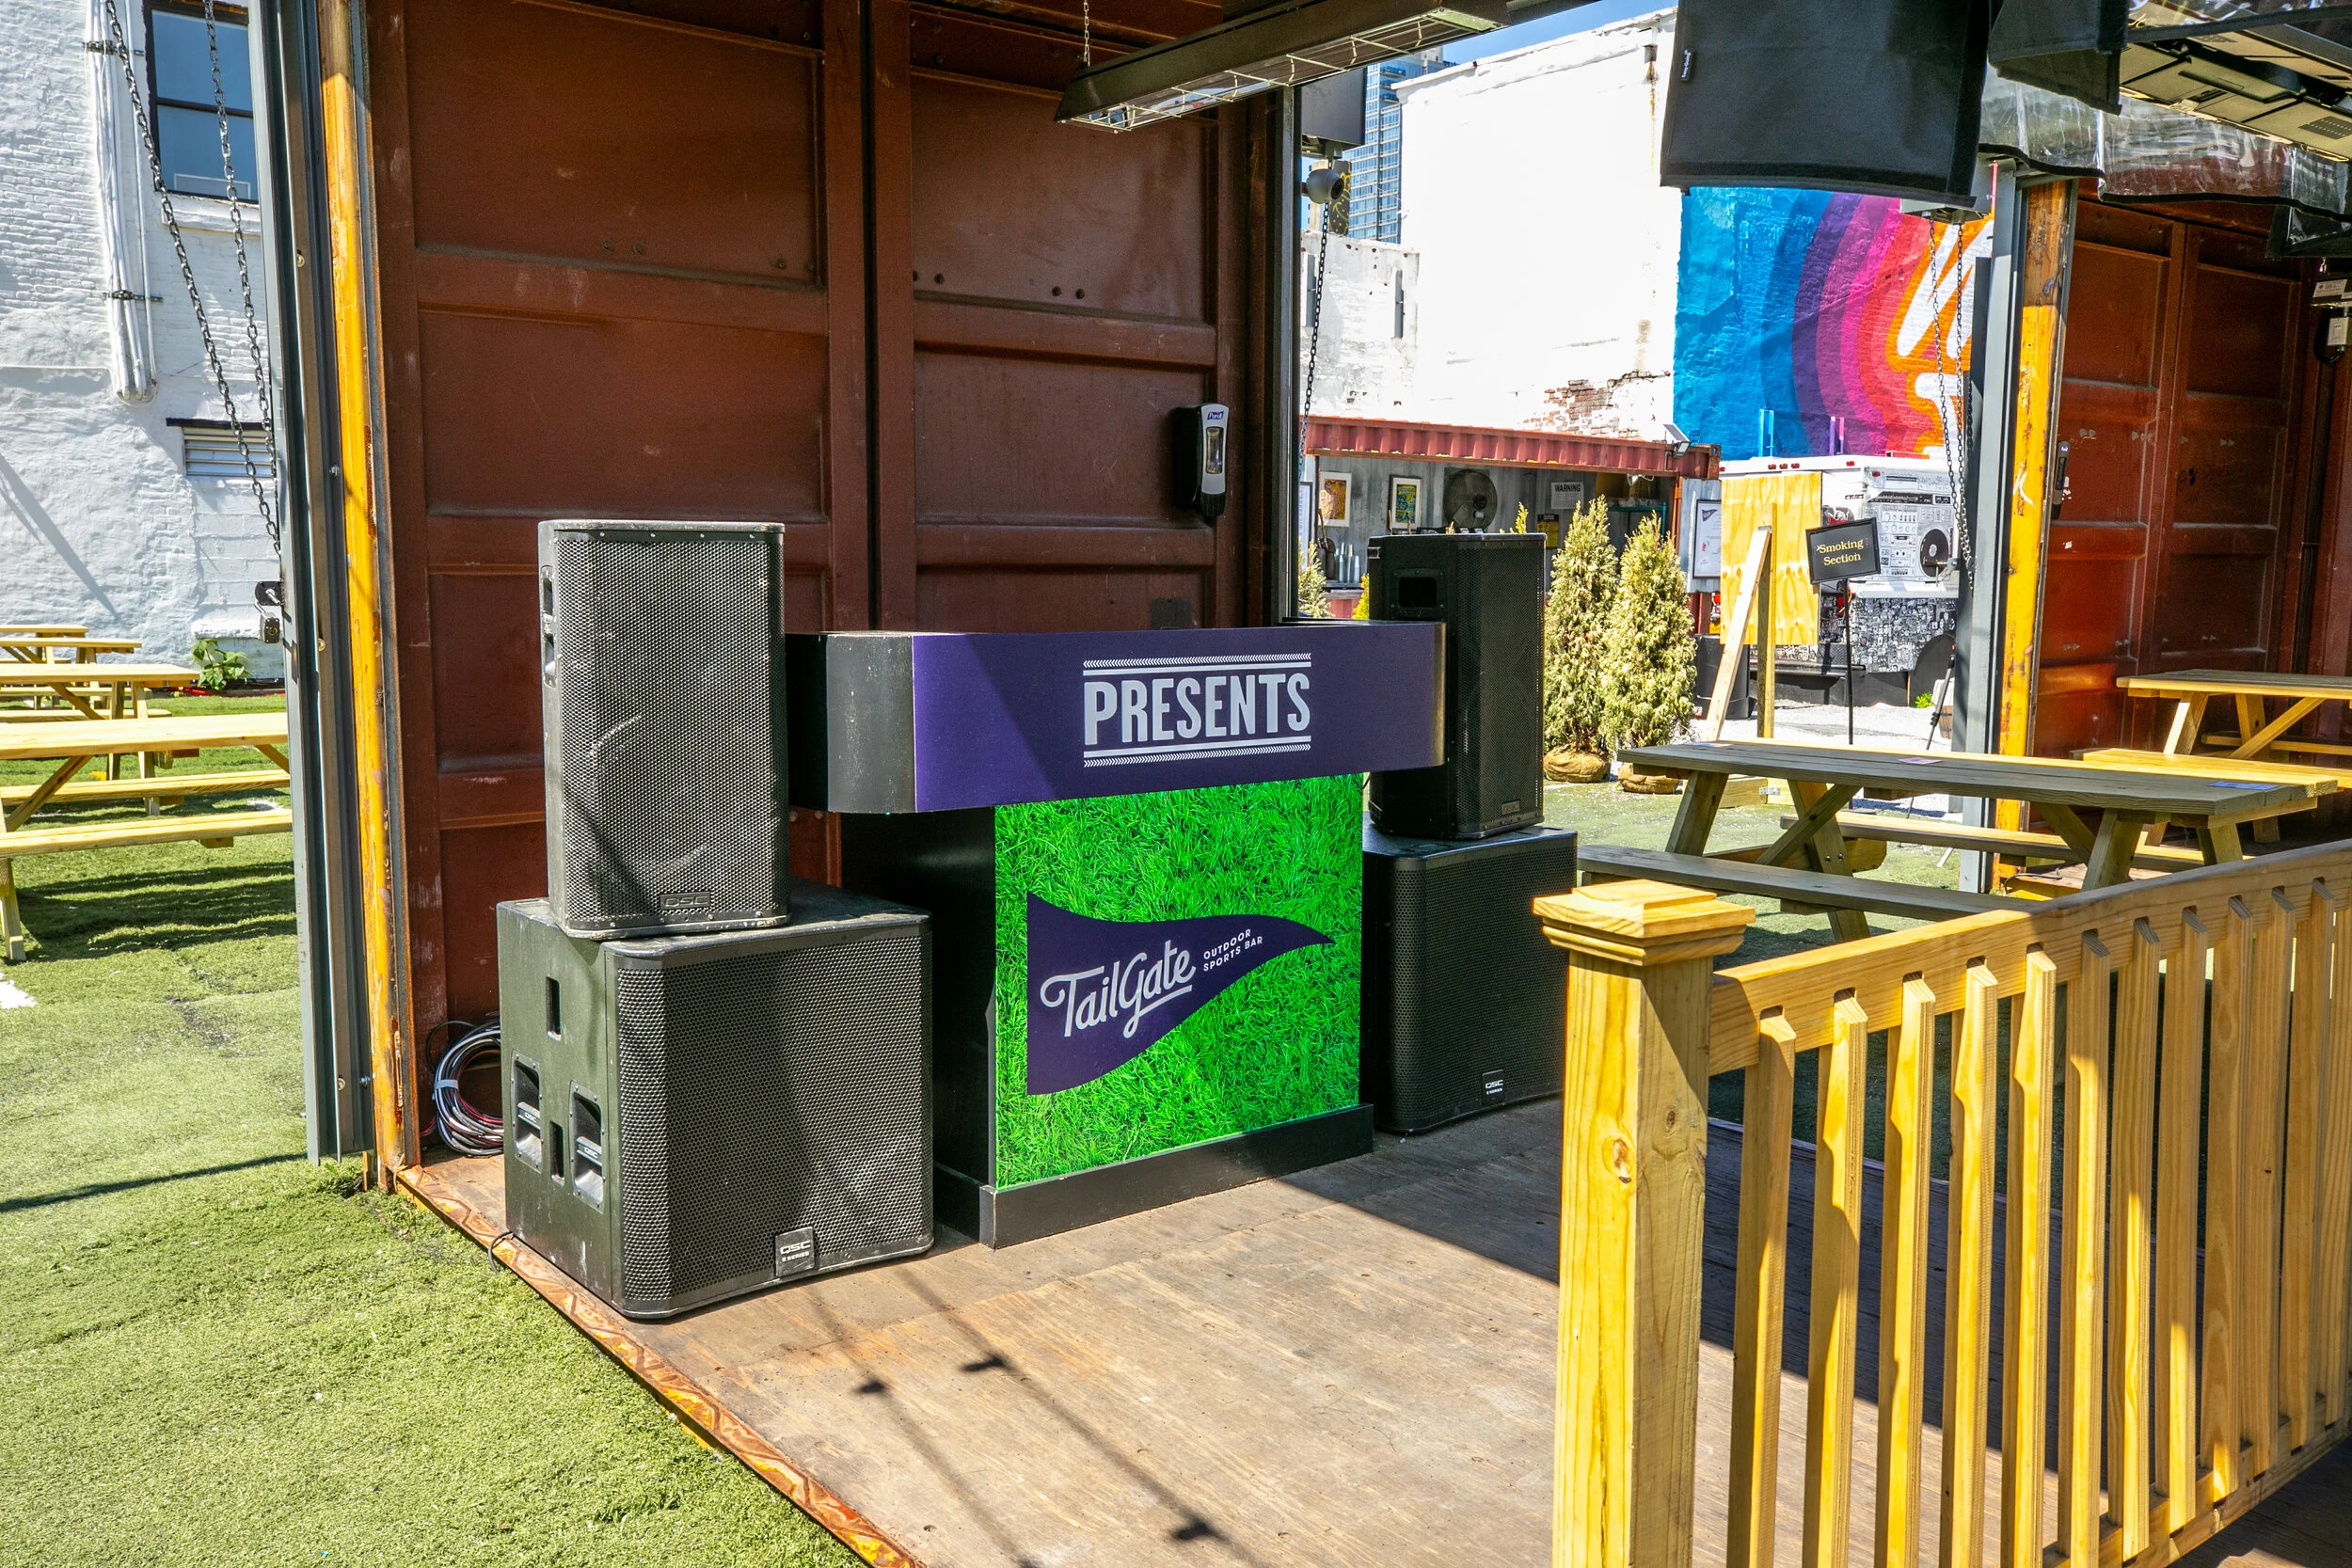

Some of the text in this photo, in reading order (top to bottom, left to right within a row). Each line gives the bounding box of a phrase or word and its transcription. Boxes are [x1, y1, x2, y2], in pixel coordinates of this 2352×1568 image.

[1555, 483, 1581, 492] WARNING
[1819, 539, 1865, 554] Smoking
[1823, 552, 1861, 566] Section
[1084, 673, 1311, 746] PRESENTS
[664, 895, 708, 908] QSC
[1203, 928, 1251, 959] OUTDOOR
[1203, 936, 1263, 972] SPORTS BAR
[1040, 940, 1197, 1038] TailGate
[1485, 1079, 1503, 1089] QSC
[780, 1240, 811, 1255] QSC
